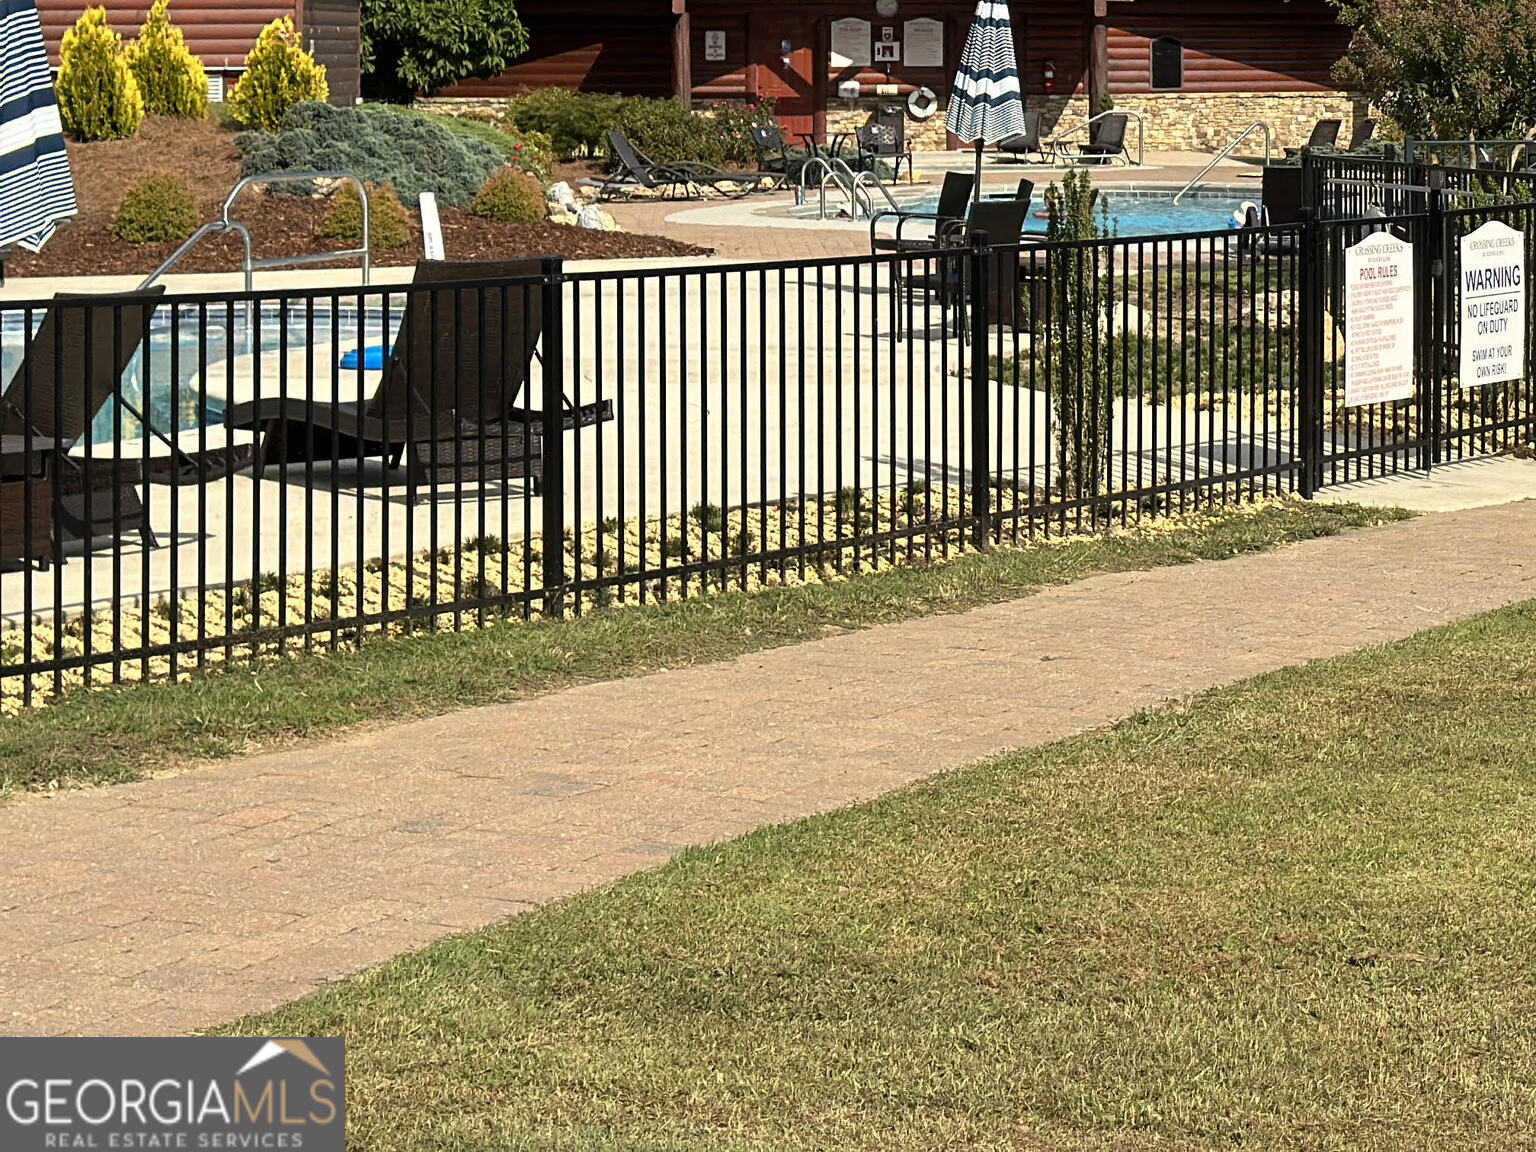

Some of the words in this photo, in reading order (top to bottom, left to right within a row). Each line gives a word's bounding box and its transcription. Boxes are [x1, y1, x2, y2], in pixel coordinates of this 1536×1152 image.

[1360, 267, 1376, 280] POOL
[1378, 265, 1398, 278] RULES
[1465, 264, 1521, 292] WARNING
[1467, 304, 1478, 319] NO
[1480, 299, 1519, 317] LIFEGUARD
[1477, 321, 1488, 335] ON
[1490, 318, 1508, 333] DUTY
[1472, 349, 1487, 362] SWIM
[1488, 348, 1495, 359] AT
[1497, 345, 1513, 358] YOUR
[1477, 366, 1491, 378] OWN
